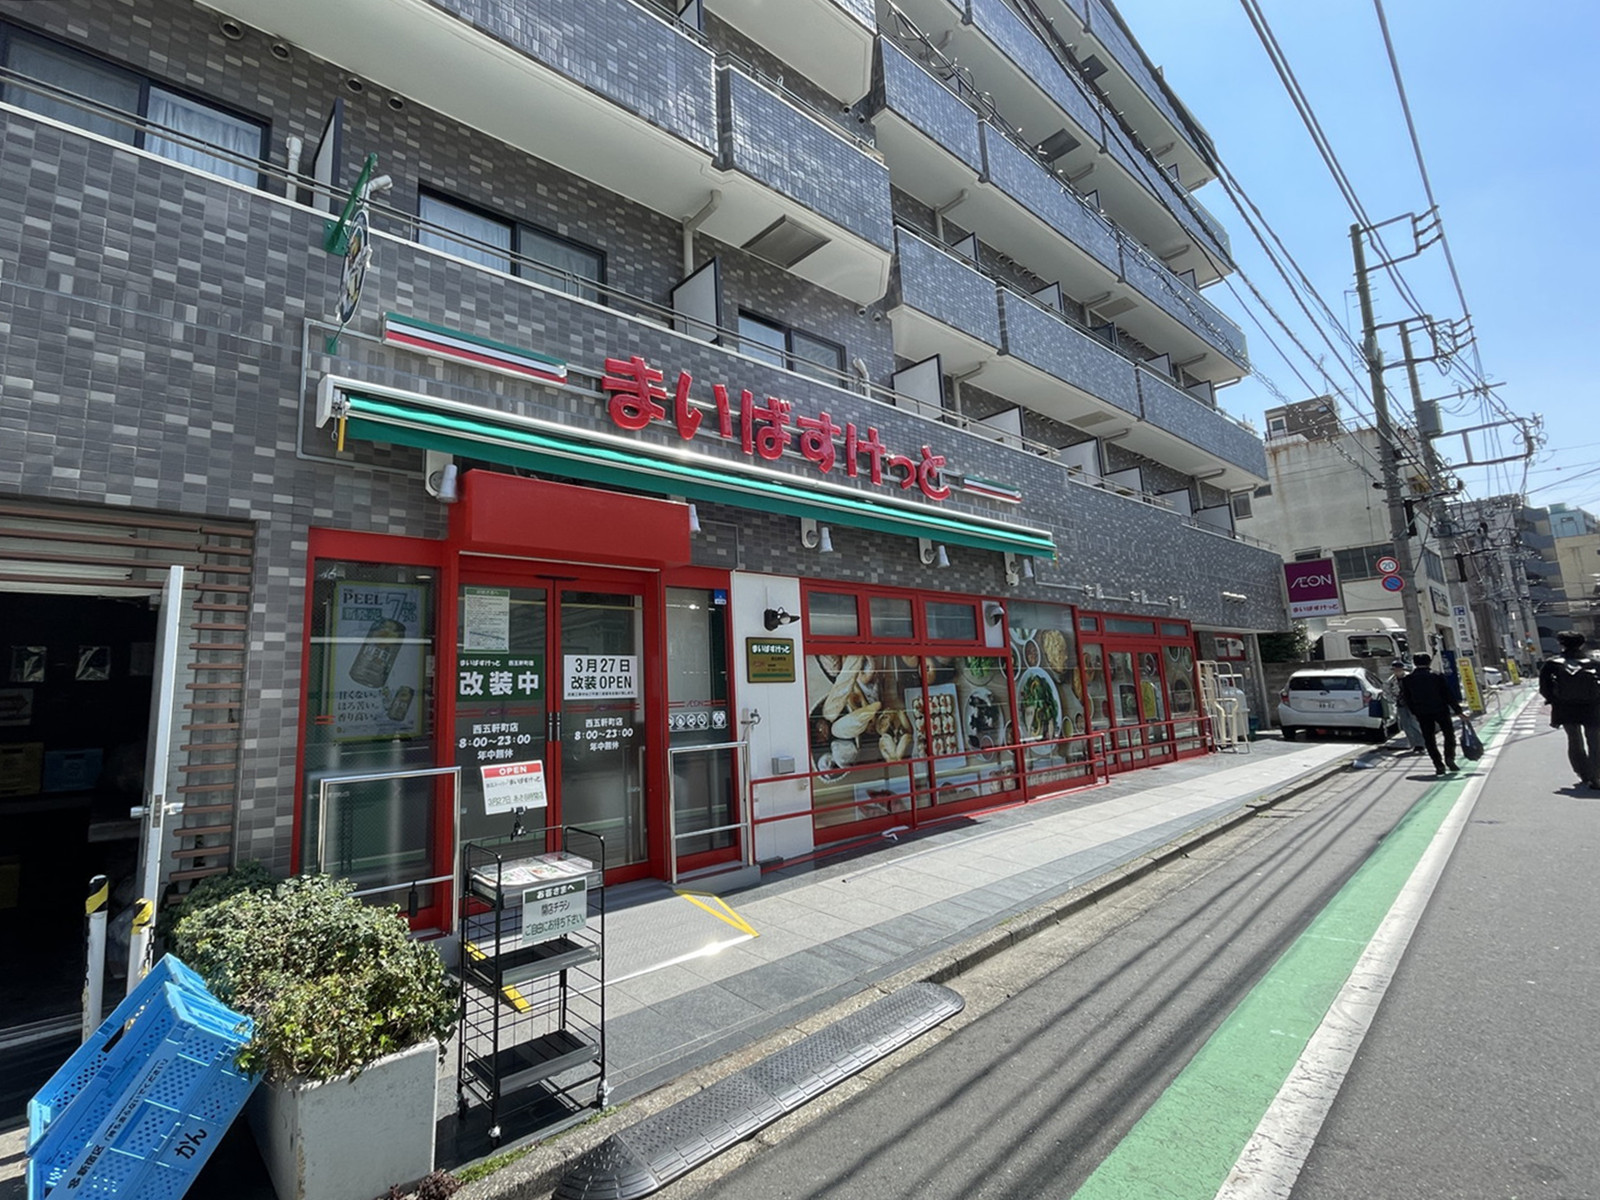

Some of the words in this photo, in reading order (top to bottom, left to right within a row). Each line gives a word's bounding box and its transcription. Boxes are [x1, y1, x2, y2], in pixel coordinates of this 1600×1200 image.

[602, 356, 952, 501] まいばすけっと
[1382, 562, 1394, 571] 20
[343, 592, 382, 606] PEEL
[344, 608, 382, 621] 新発売
[1293, 604, 1339, 613] まいばすけっと
[752, 644, 790, 654] まいばすけっと
[460, 659, 501, 667] まいばすけっと
[575, 658, 630, 673] 3月27日
[459, 671, 539, 696] 改装中
[571, 675, 632, 690] 改装OPEN
[472, 722, 519, 735] 西五軒町店
[585, 717, 624, 728] 西五軒町店
[589, 741, 620, 752] 年中無休
[477, 748, 514, 761] 年中無休
[499, 765, 527, 776] OPEN
[541, 900, 571, 916] 開店チラシ
[77, 1144, 106, 1177] 新宿区
